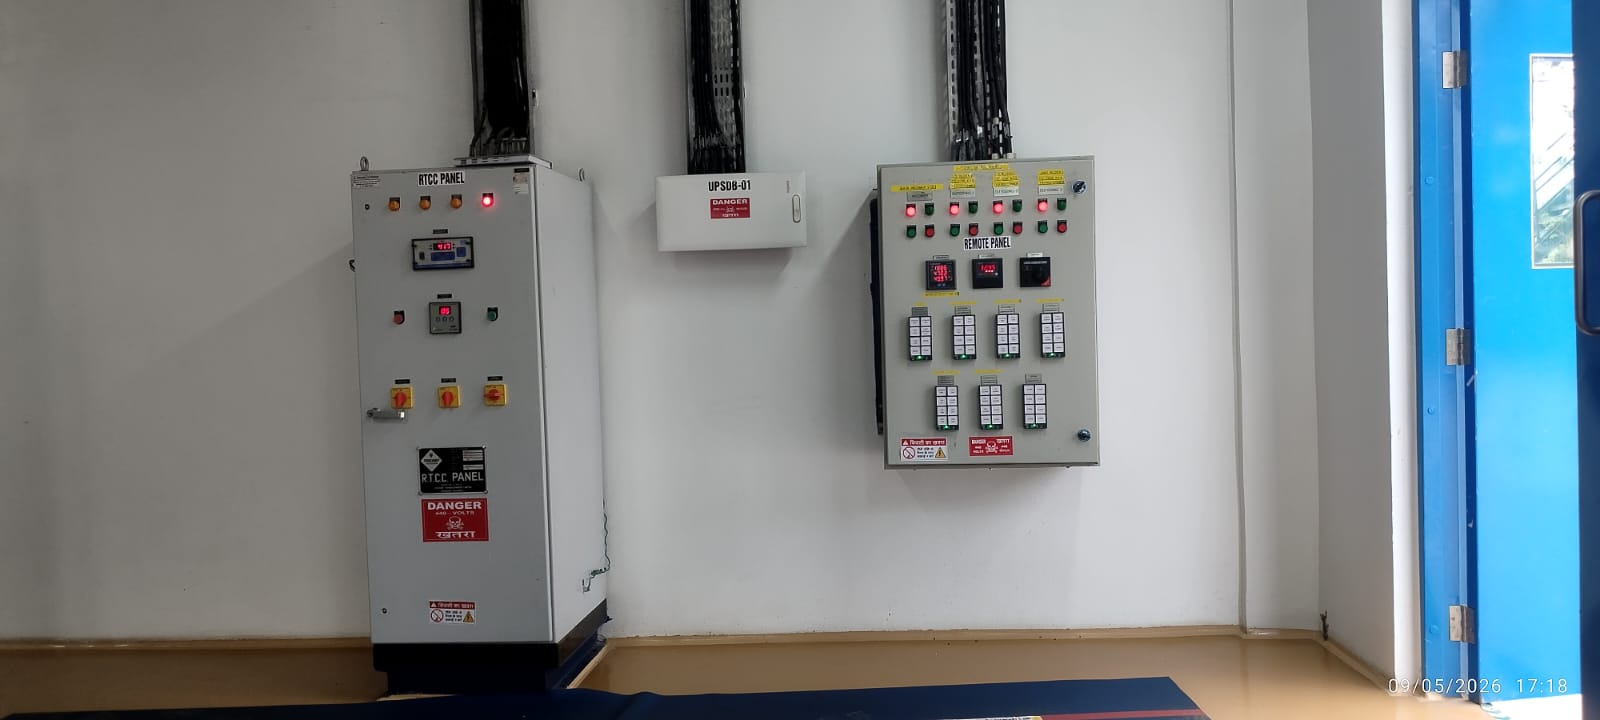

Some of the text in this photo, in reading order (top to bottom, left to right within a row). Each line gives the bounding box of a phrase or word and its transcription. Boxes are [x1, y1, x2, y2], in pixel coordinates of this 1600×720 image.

[418, 172, 465, 186] RTCC PANEL
[708, 179, 751, 192] UPSDB-01
[964, 236, 1011, 250] REMOTE PANEL
[452, 472, 484, 482] PANEL
[427, 501, 482, 510] DANGER
[435, 531, 476, 539] खतरा
